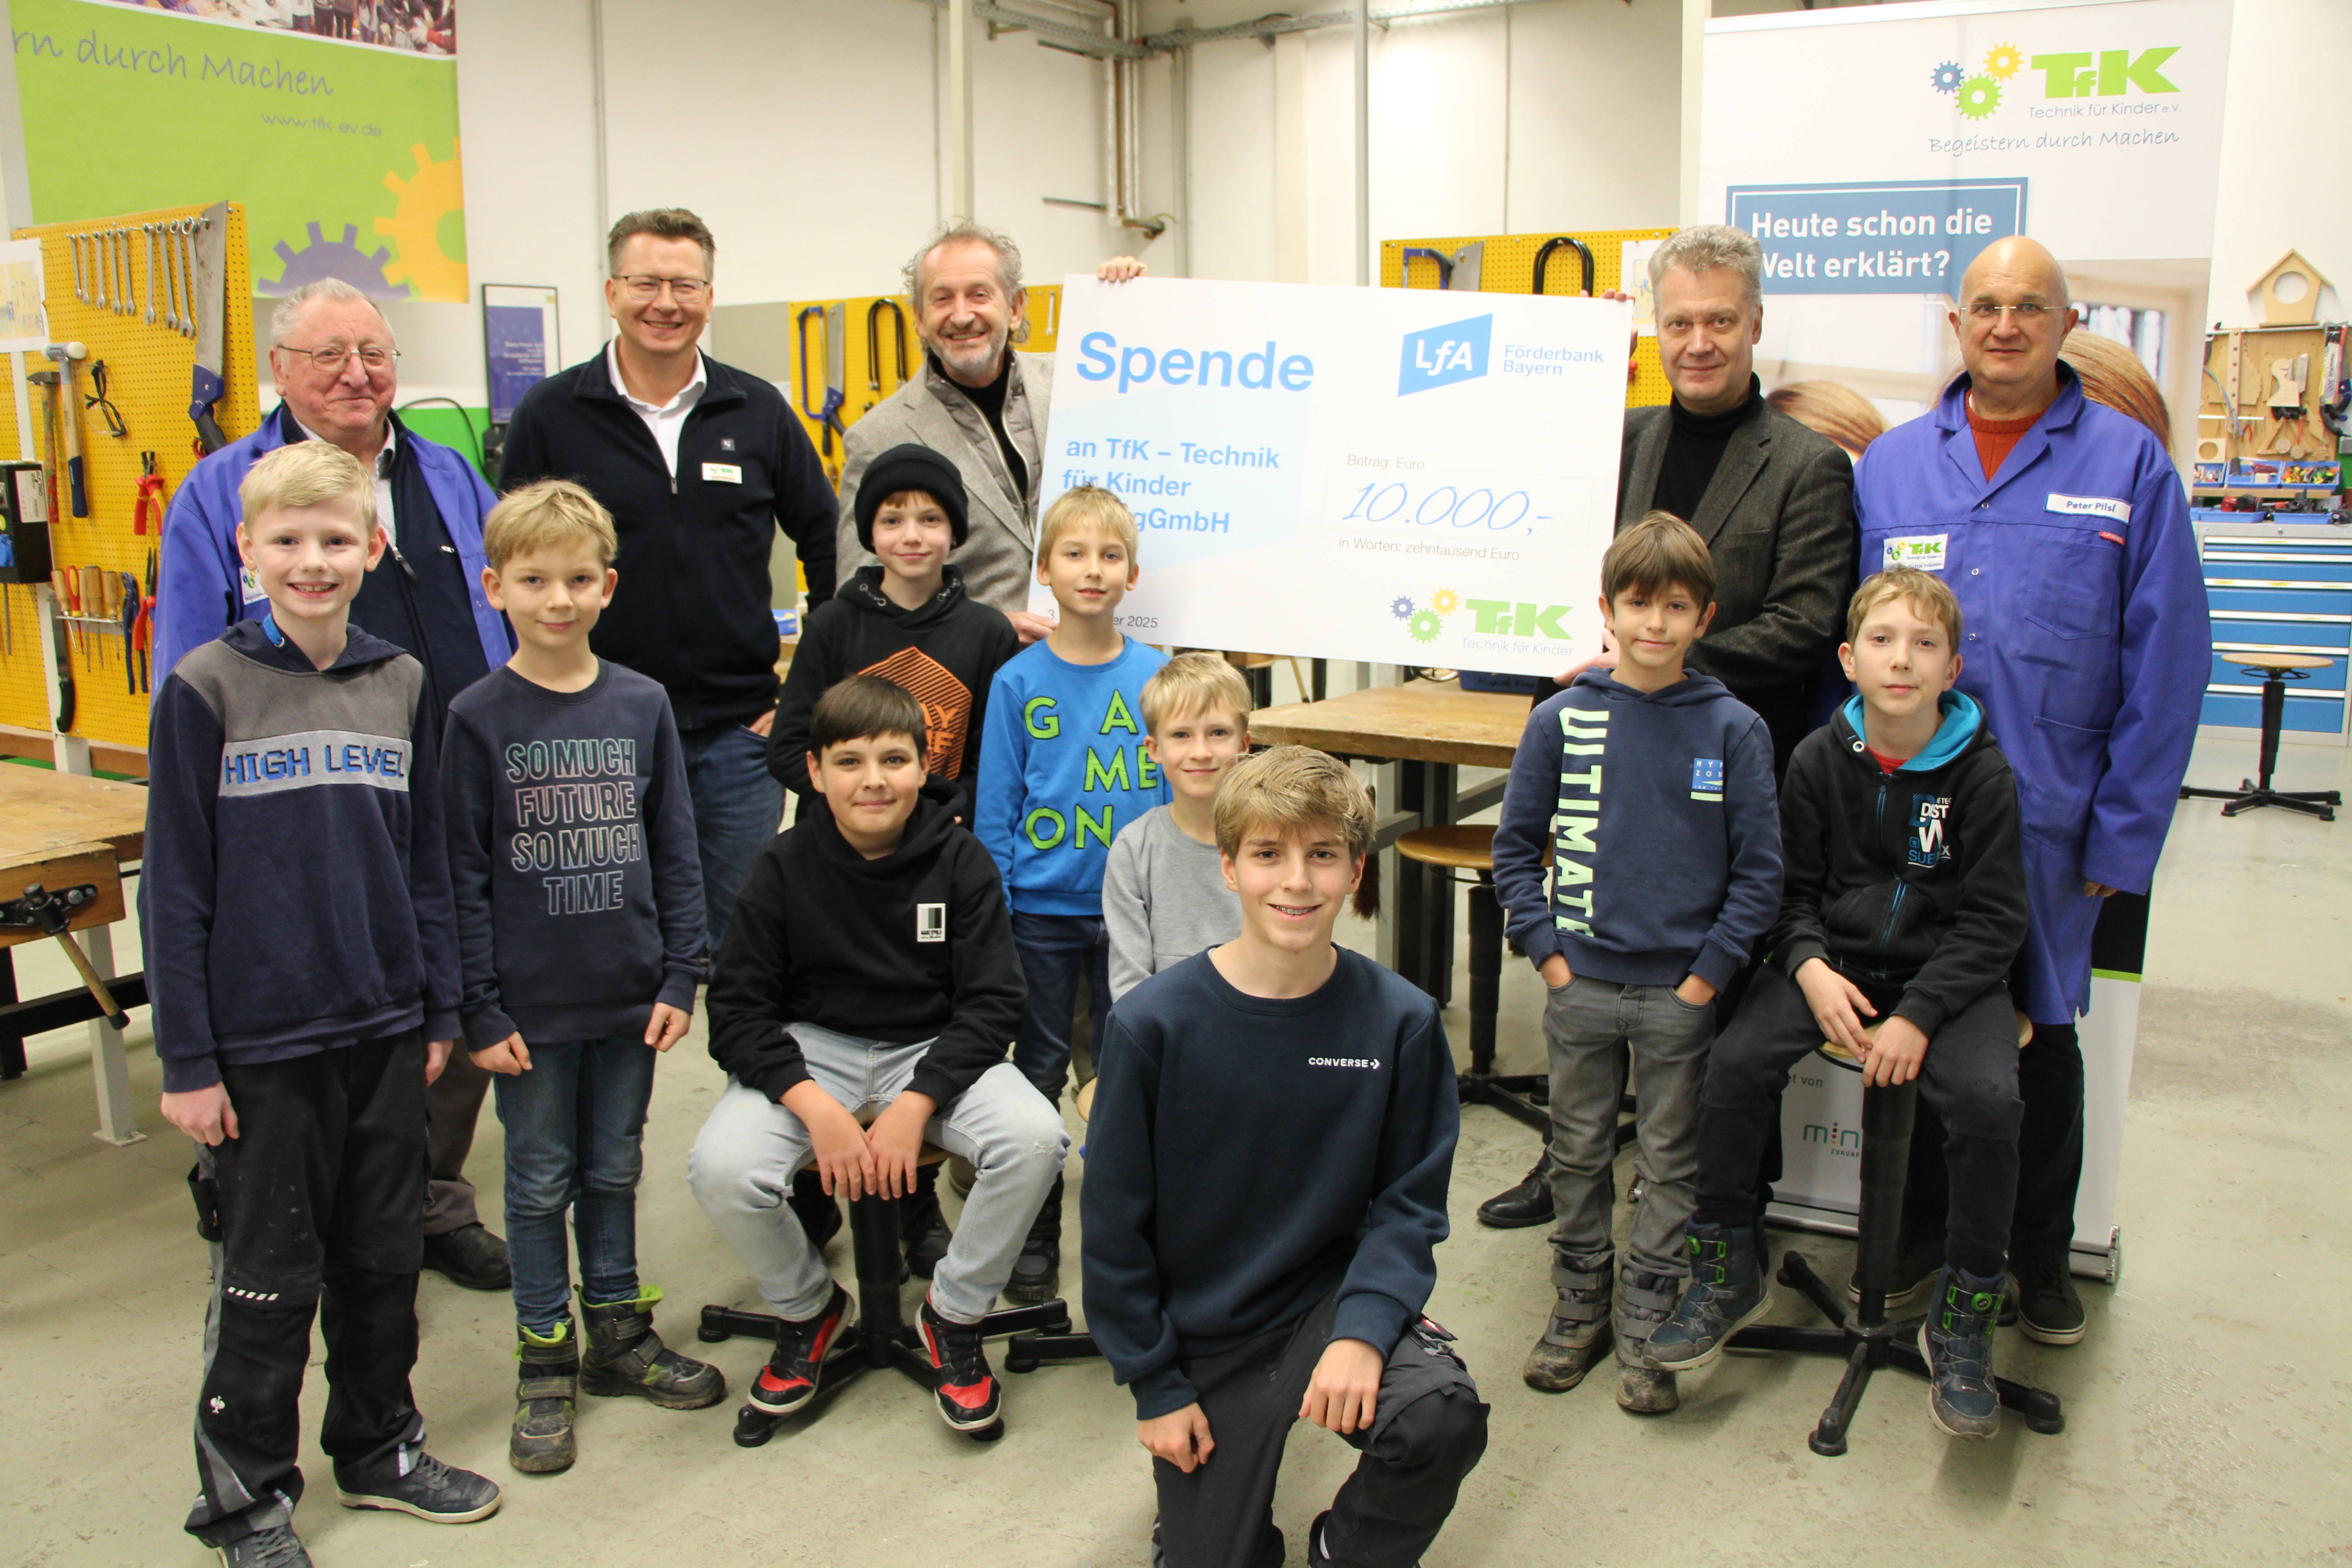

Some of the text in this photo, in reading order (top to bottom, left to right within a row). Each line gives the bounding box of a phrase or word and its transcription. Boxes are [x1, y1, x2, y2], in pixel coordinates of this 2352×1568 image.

[77, 29, 187, 78] durch
[201, 54, 334, 96] Machen
[2030, 46, 2182, 99] TfK
[2029, 105, 2084, 119] Technik
[2088, 103, 2107, 117] für
[2111, 102, 2160, 115] Kinder
[1927, 128, 2180, 157] Begeistern durch Machen
[1751, 207, 1992, 239] Heute schon die
[1824, 250, 1950, 278] erklärt?
[1076, 331, 1314, 394] Spende
[1415, 339, 1473, 377] LfA
[1503, 360, 1563, 377] Bayern
[1504, 344, 1604, 363] Förderbank
[1066, 440, 1097, 458] an
[1106, 438, 1150, 461] TfK
[1180, 442, 1281, 469] Technik
[1347, 454, 1425, 470] Betrag: Euro
[1063, 469, 1192, 497] für Kinder
[2066, 500, 2092, 509] Peter
[1338, 537, 1520, 561] in Worten: zehntausend Euro
[1127, 616, 1158, 628] 2025
[1465, 598, 1574, 641] TfK
[1462, 637, 1574, 657] Technik für Kinder
[225, 745, 405, 784] HIGH LEVEL
[505, 738, 637, 784] SO MUCH
[1083, 745, 1157, 793] ME
[515, 781, 637, 828] FUTURE
[1024, 804, 1114, 850] ON
[511, 823, 641, 872] SO MUCH
[543, 870, 624, 916] TIME
[1308, 1057, 1369, 1068] CONVERSE
[1801, 1076, 1823, 1087] von
[1830, 1148, 1861, 1158] ZUKUNF
